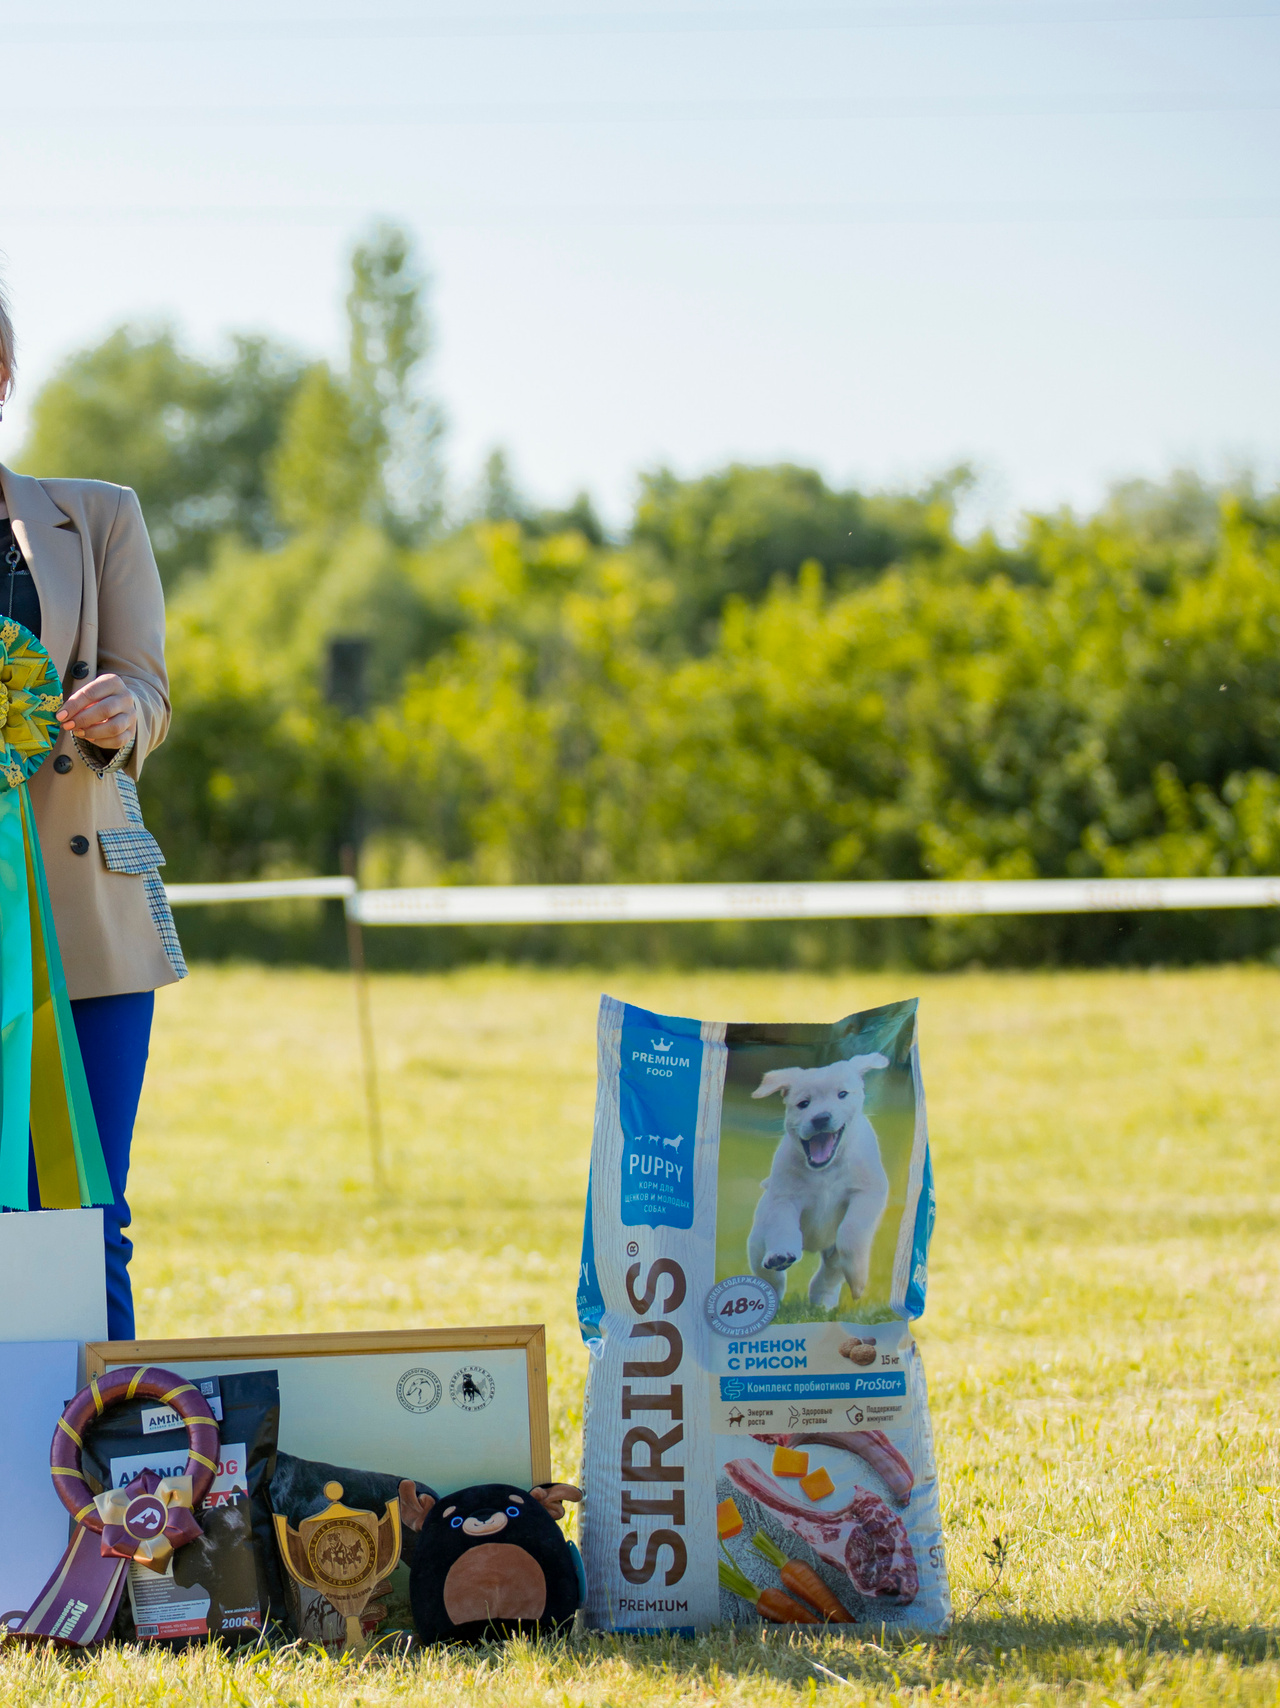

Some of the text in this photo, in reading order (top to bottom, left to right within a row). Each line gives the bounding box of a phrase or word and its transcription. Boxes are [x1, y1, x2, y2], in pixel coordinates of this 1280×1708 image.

[631, 1051, 691, 1068] PREMIUM
[646, 1067, 673, 1078] FOOD
[629, 1154, 684, 1183] PUPPY
[638, 1181, 674, 1193] КОРМ ДЛЯ
[624, 1192, 648, 1203] ЩЕНКОВ
[657, 1194, 690, 1209] МОЛОДЫХ
[643, 1204, 667, 1214] СОБАК
[707, 1284, 724, 1314] ВЫСОКОЕ
[723, 1277, 769, 1291] СОДЕРЖАНИЕ
[719, 1297, 765, 1317] 48%
[727, 1338, 807, 1354] ЯГНЕНОК
[727, 1355, 808, 1371] С РИСОМ
[881, 1355, 890, 1366] 15
[747, 1377, 902, 1394] Комплекс пробиотиков ProStor+
[747, 1408, 773, 1419] Энергия
[801, 1407, 833, 1417] Здоровые
[149, 1413, 184, 1427] AMIN
[620, 1257, 687, 1587] SIRIUS
[747, 1418, 766, 1427] роста
[801, 1416, 828, 1426] суставы
[620, 1598, 688, 1612] PREMIUM
[221, 1616, 249, 1629] 2000
